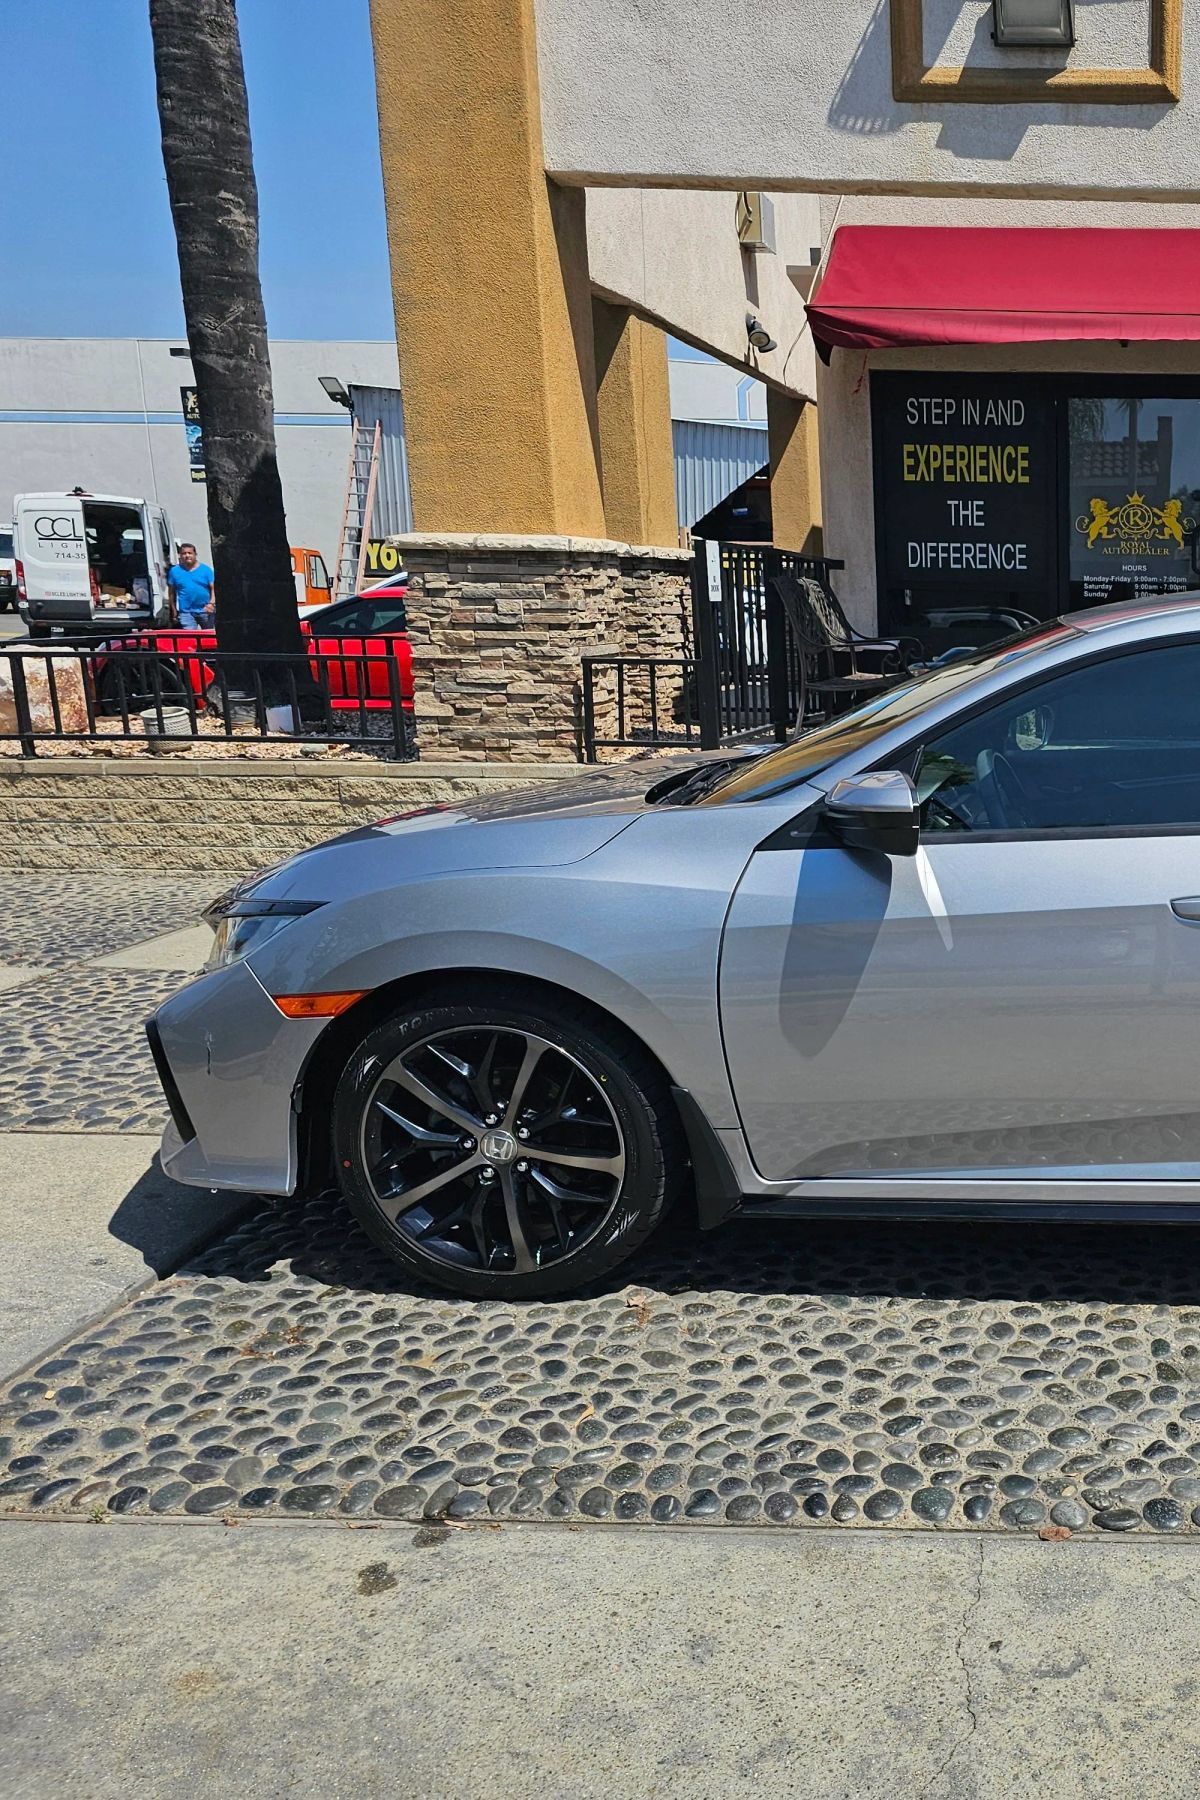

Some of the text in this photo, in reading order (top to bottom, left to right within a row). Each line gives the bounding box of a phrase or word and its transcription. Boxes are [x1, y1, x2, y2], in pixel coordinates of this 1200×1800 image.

[906, 397, 1026, 427] STEP IN AND
[903, 443, 1030, 485] EXPERIENCE
[946, 499, 986, 527] THE
[1129, 509, 1144, 526] R
[1102, 547, 1170, 555] AUTO DEALER
[1120, 541, 1151, 549] ROYAL
[366, 542, 403, 571] YO
[907, 541, 1028, 571] DIFFERENCE
[1083, 575, 1131, 583] Monday-Friday
[1163, 576, 1187, 584] 7:00pm
[1083, 583, 1113, 591] Saturday
[1083, 591, 1108, 599] Sunday
